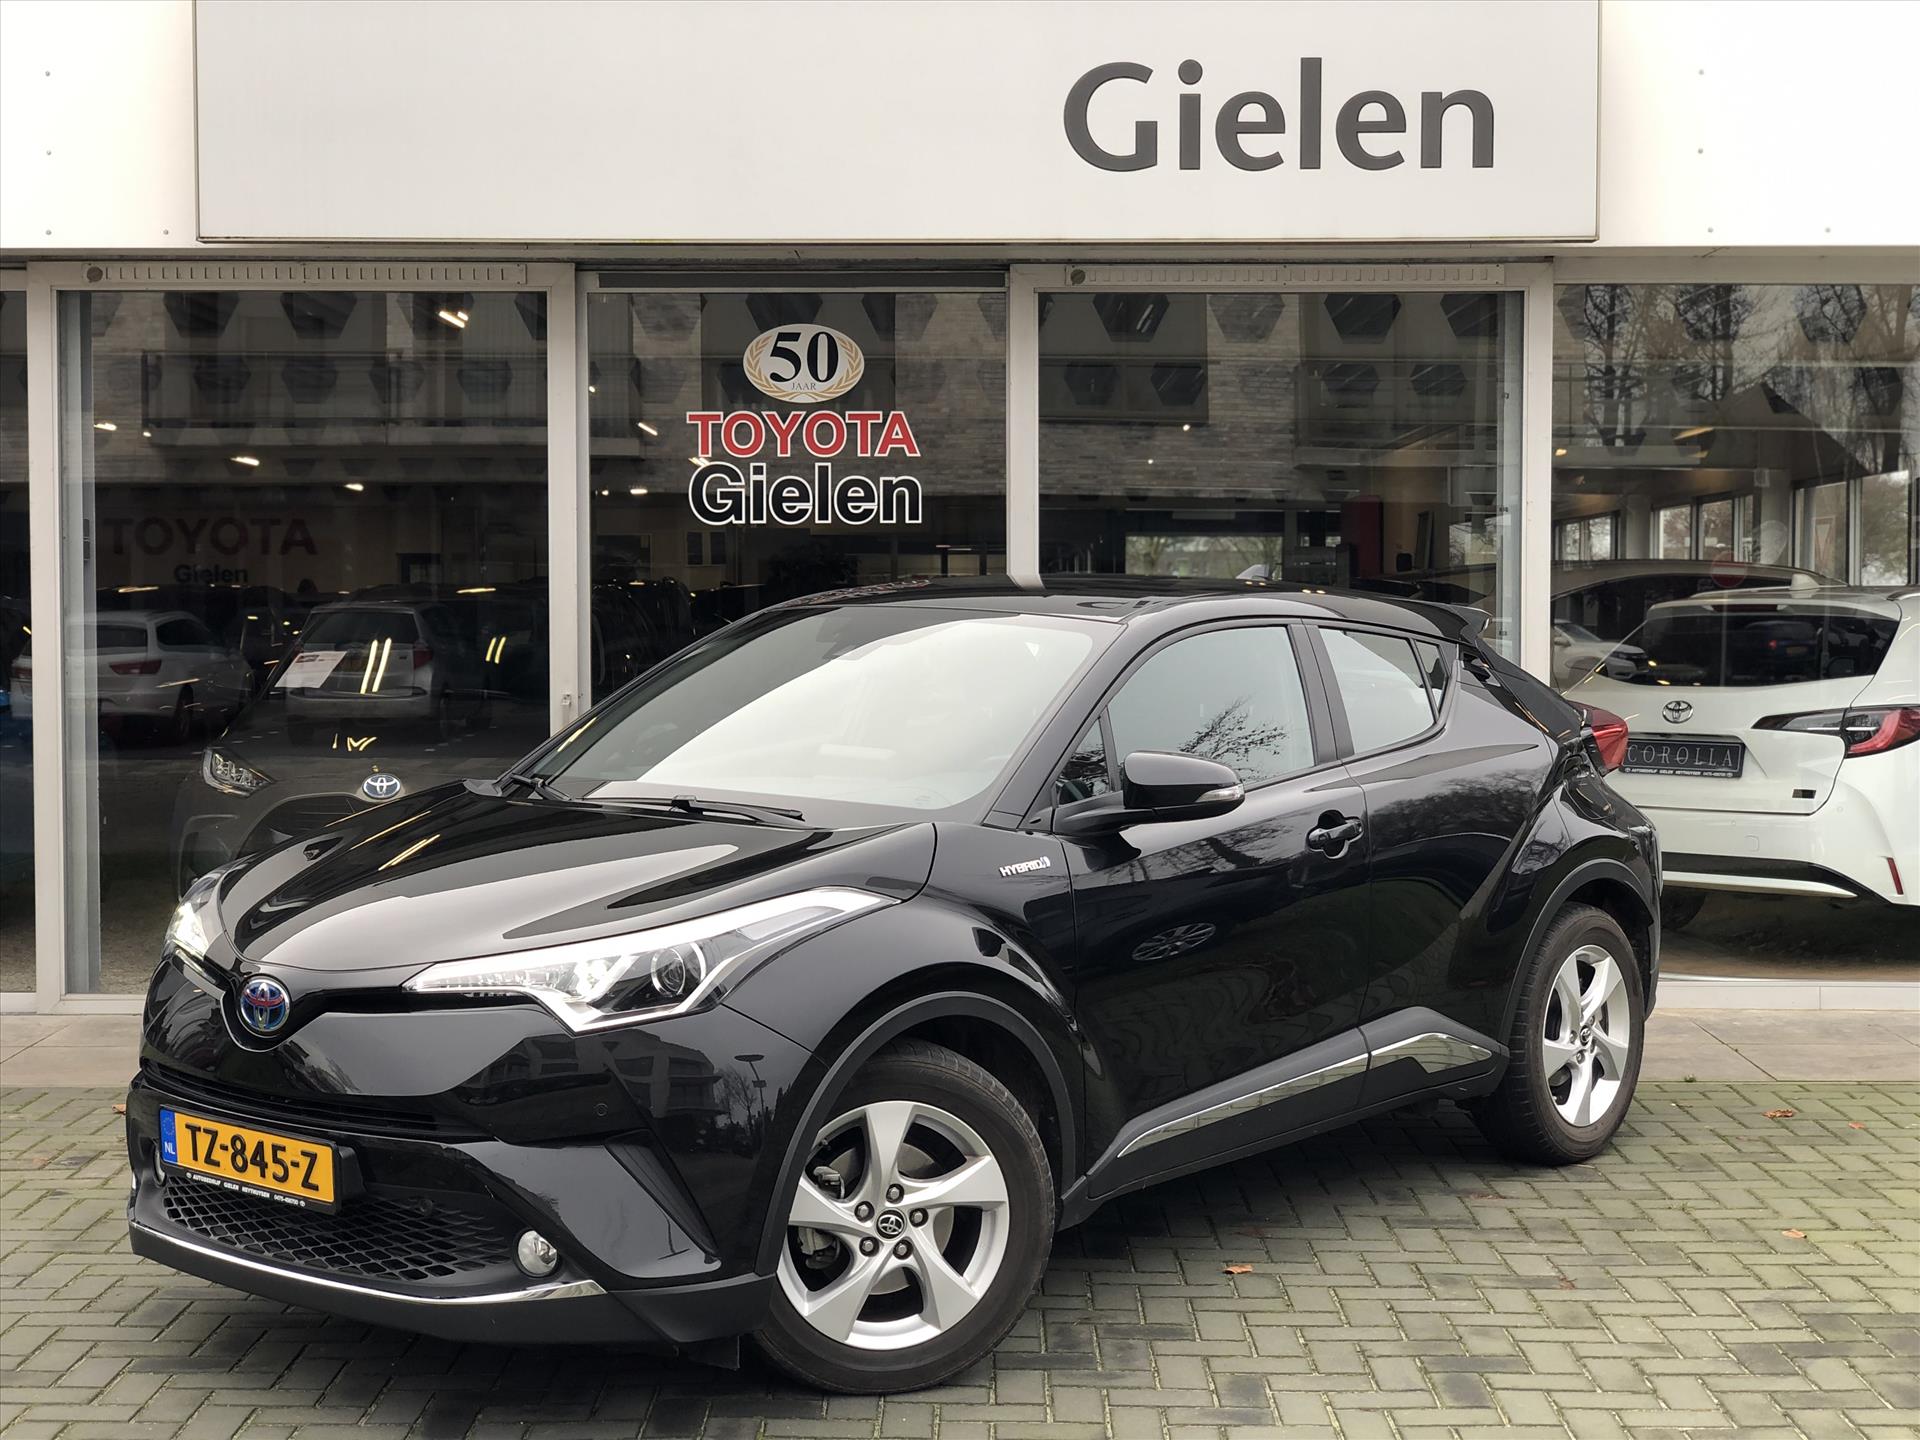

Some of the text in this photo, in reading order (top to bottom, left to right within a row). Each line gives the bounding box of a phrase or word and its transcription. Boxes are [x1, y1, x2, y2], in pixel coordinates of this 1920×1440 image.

[1063, 57, 1495, 172] Gielen
[769, 331, 839, 383] 50
[790, 381, 817, 391] JAAR
[687, 411, 921, 457] TOYOTA
[689, 461, 922, 525] Gielen
[103, 517, 319, 555] TOYOTA
[174, 564, 249, 583] Gielen
[1627, 744, 1733, 767] COROLLA
[999, 859, 1042, 877] HYBRID
[164, 1141, 176, 1156] NL
[185, 1122, 320, 1192] TZ-845-Z
